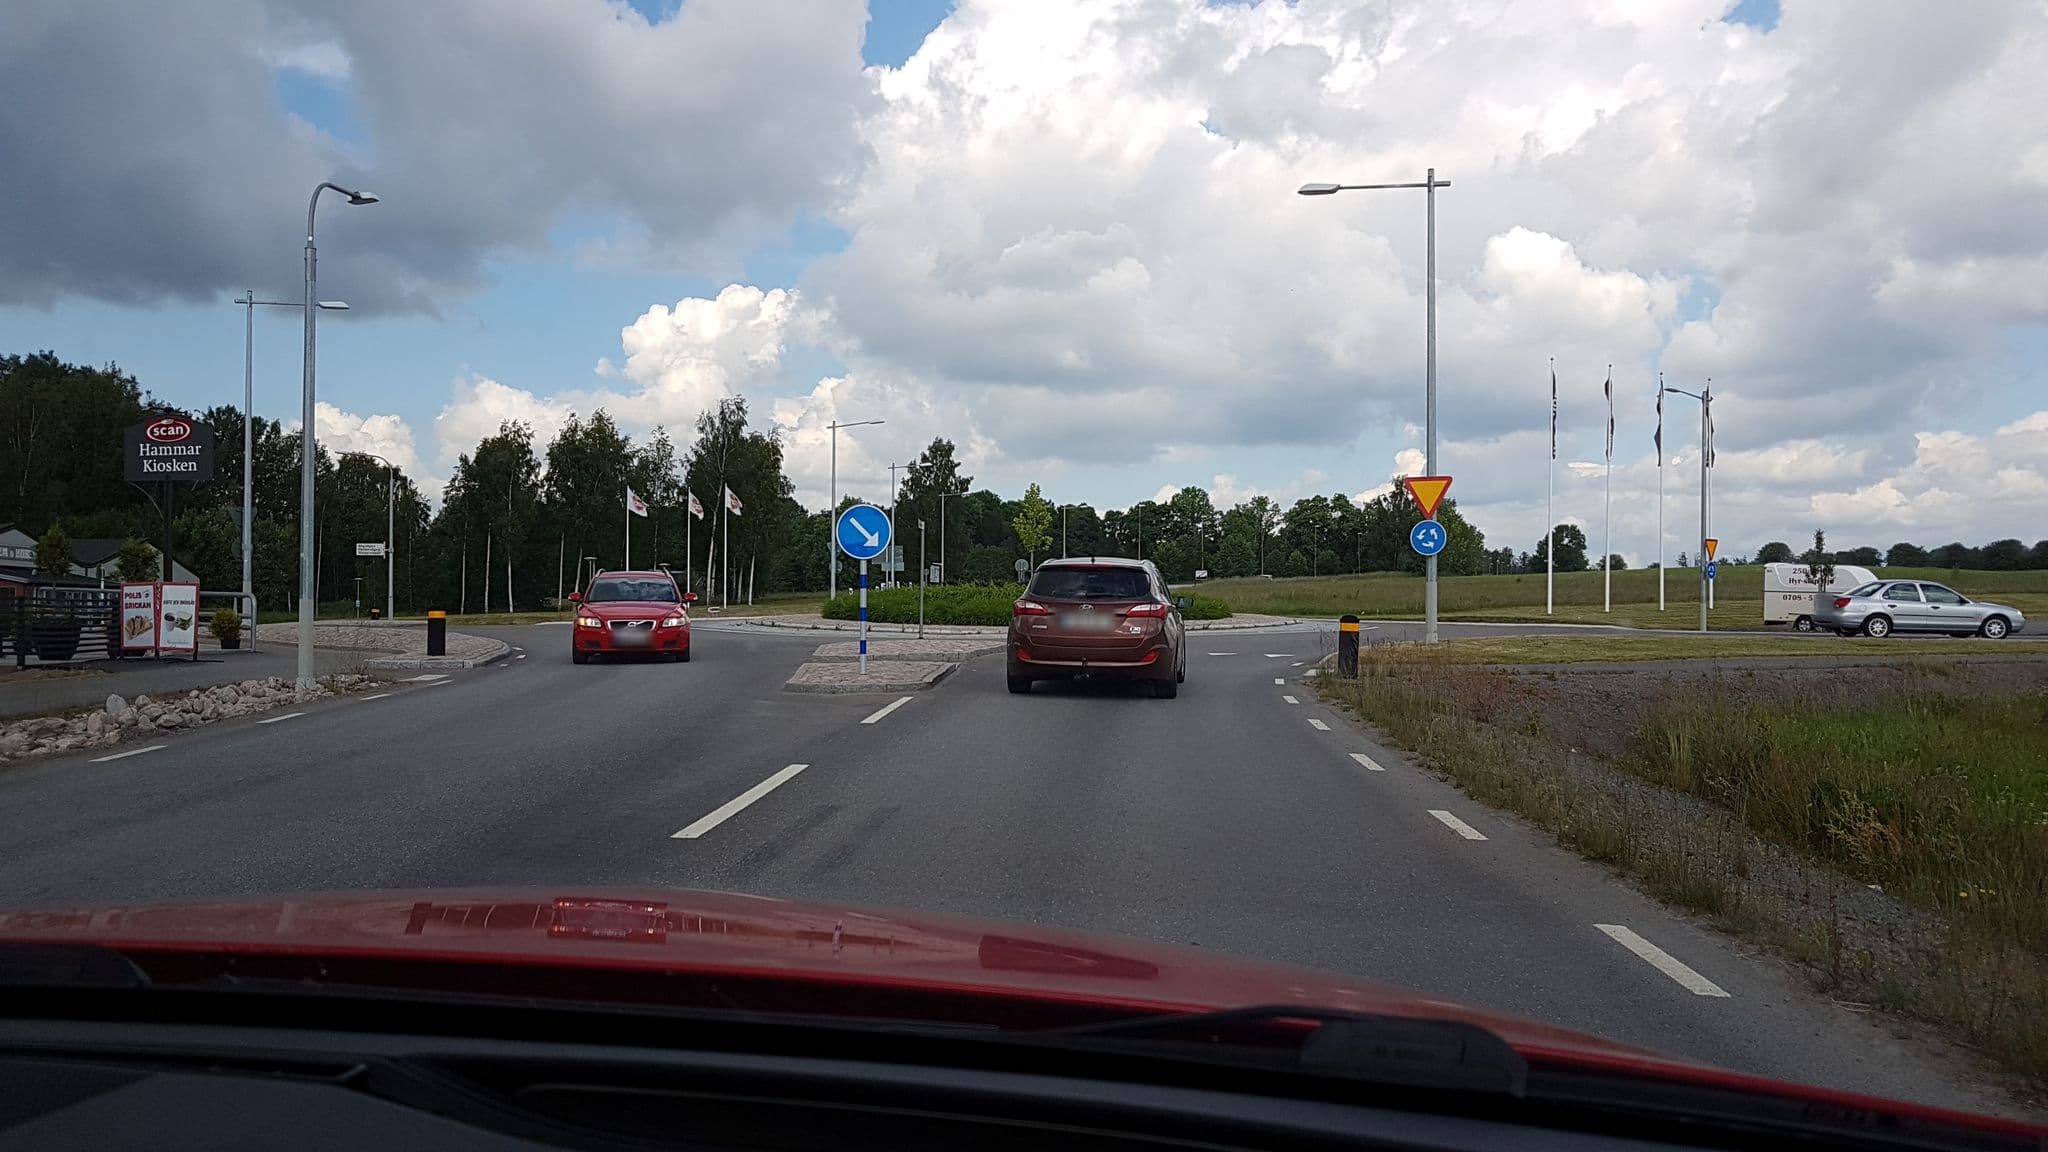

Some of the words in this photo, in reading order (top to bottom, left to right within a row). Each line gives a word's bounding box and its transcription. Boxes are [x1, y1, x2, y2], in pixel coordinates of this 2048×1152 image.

[153, 426, 184, 436] scan
[139, 443, 202, 456] Hammar
[143, 459, 197, 473] Kiosken
